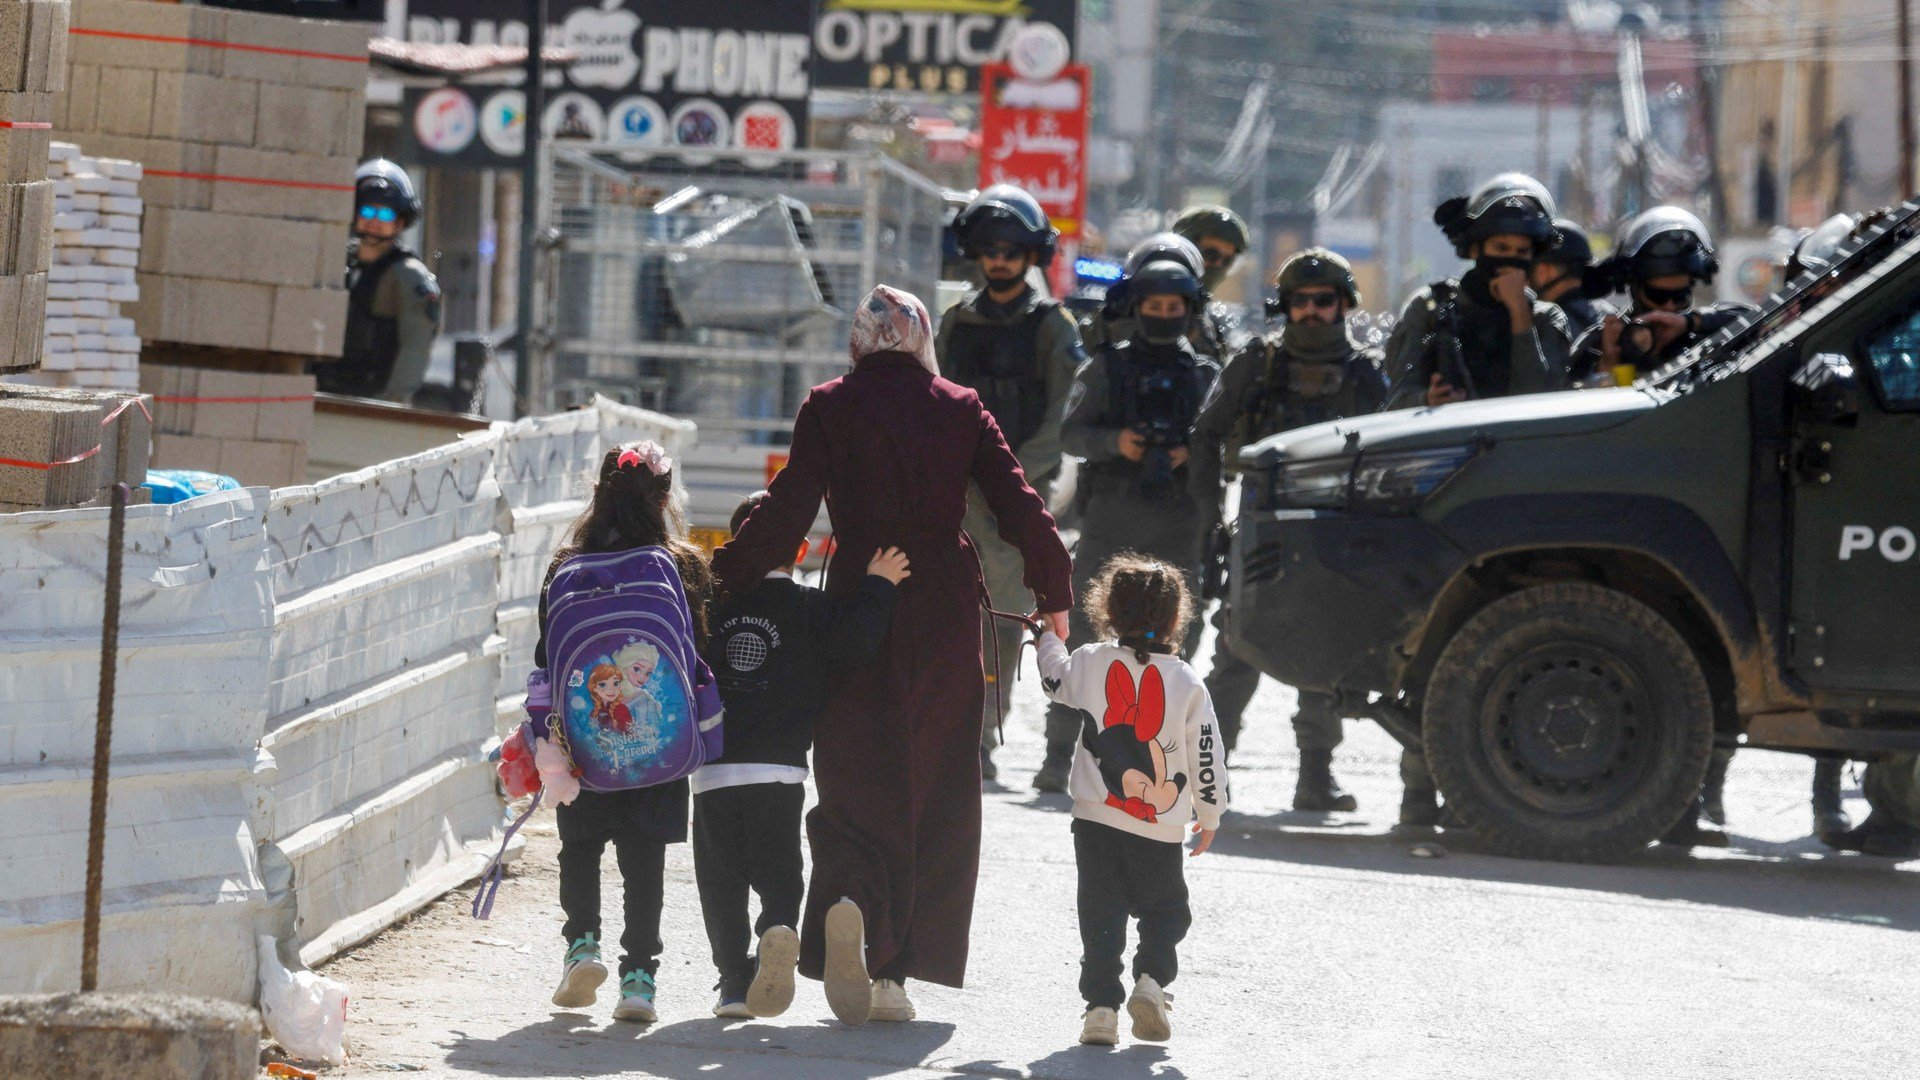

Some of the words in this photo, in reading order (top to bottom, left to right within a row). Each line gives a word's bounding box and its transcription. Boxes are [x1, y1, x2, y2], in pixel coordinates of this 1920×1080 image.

[640, 26, 810, 99] PHONE
[870, 64, 967, 93] PLUS
[741, 615, 781, 648] nothing
[1199, 723, 1217, 805] MOUSE
